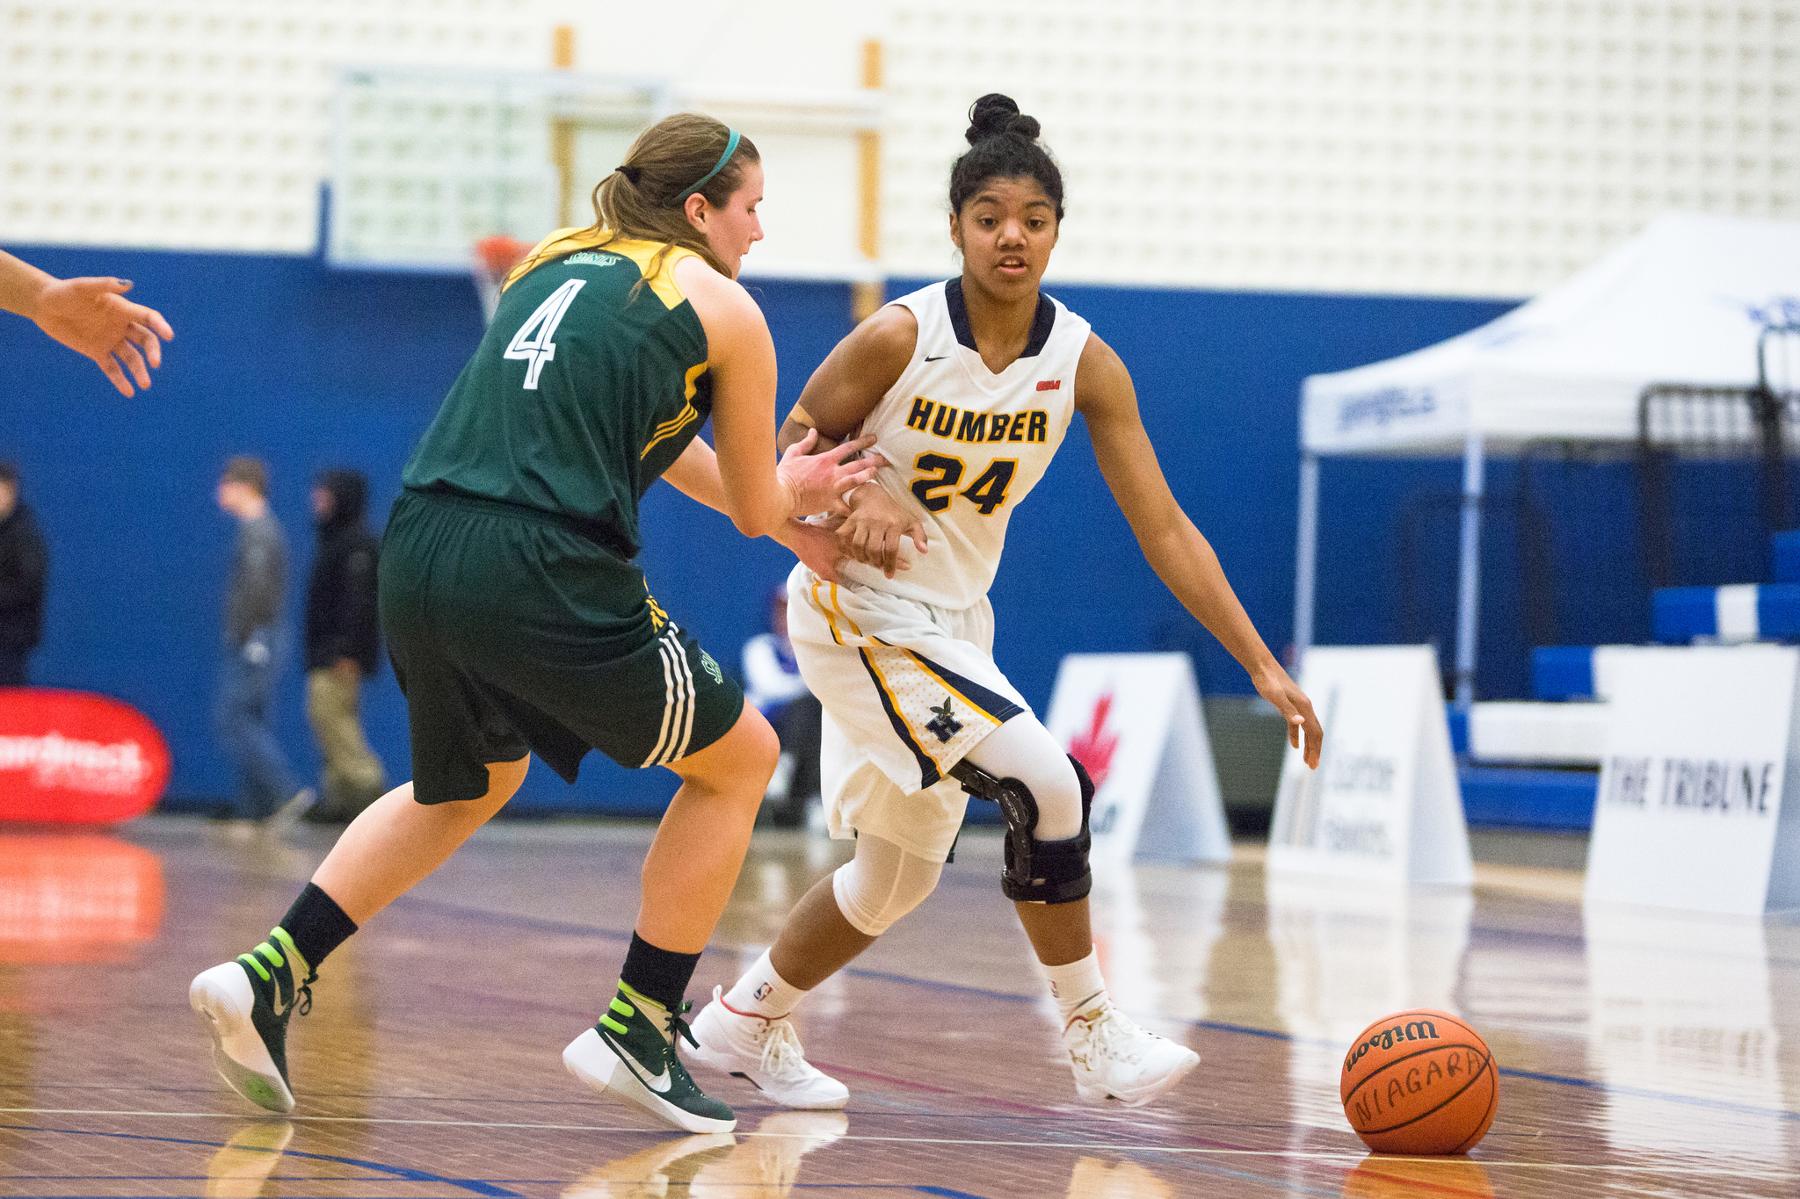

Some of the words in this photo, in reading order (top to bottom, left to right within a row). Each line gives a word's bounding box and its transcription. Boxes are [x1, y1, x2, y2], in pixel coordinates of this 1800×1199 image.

[503, 278, 587, 390] 4
[906, 396, 1048, 444] HUMBER
[909, 450, 1019, 517] 24
[1607, 755, 1652, 807] THE
[1660, 757, 1775, 815] TRIBUNE
[1345, 1020, 1440, 1072] Wilson
[1355, 1051, 1482, 1128] NIAGARA
